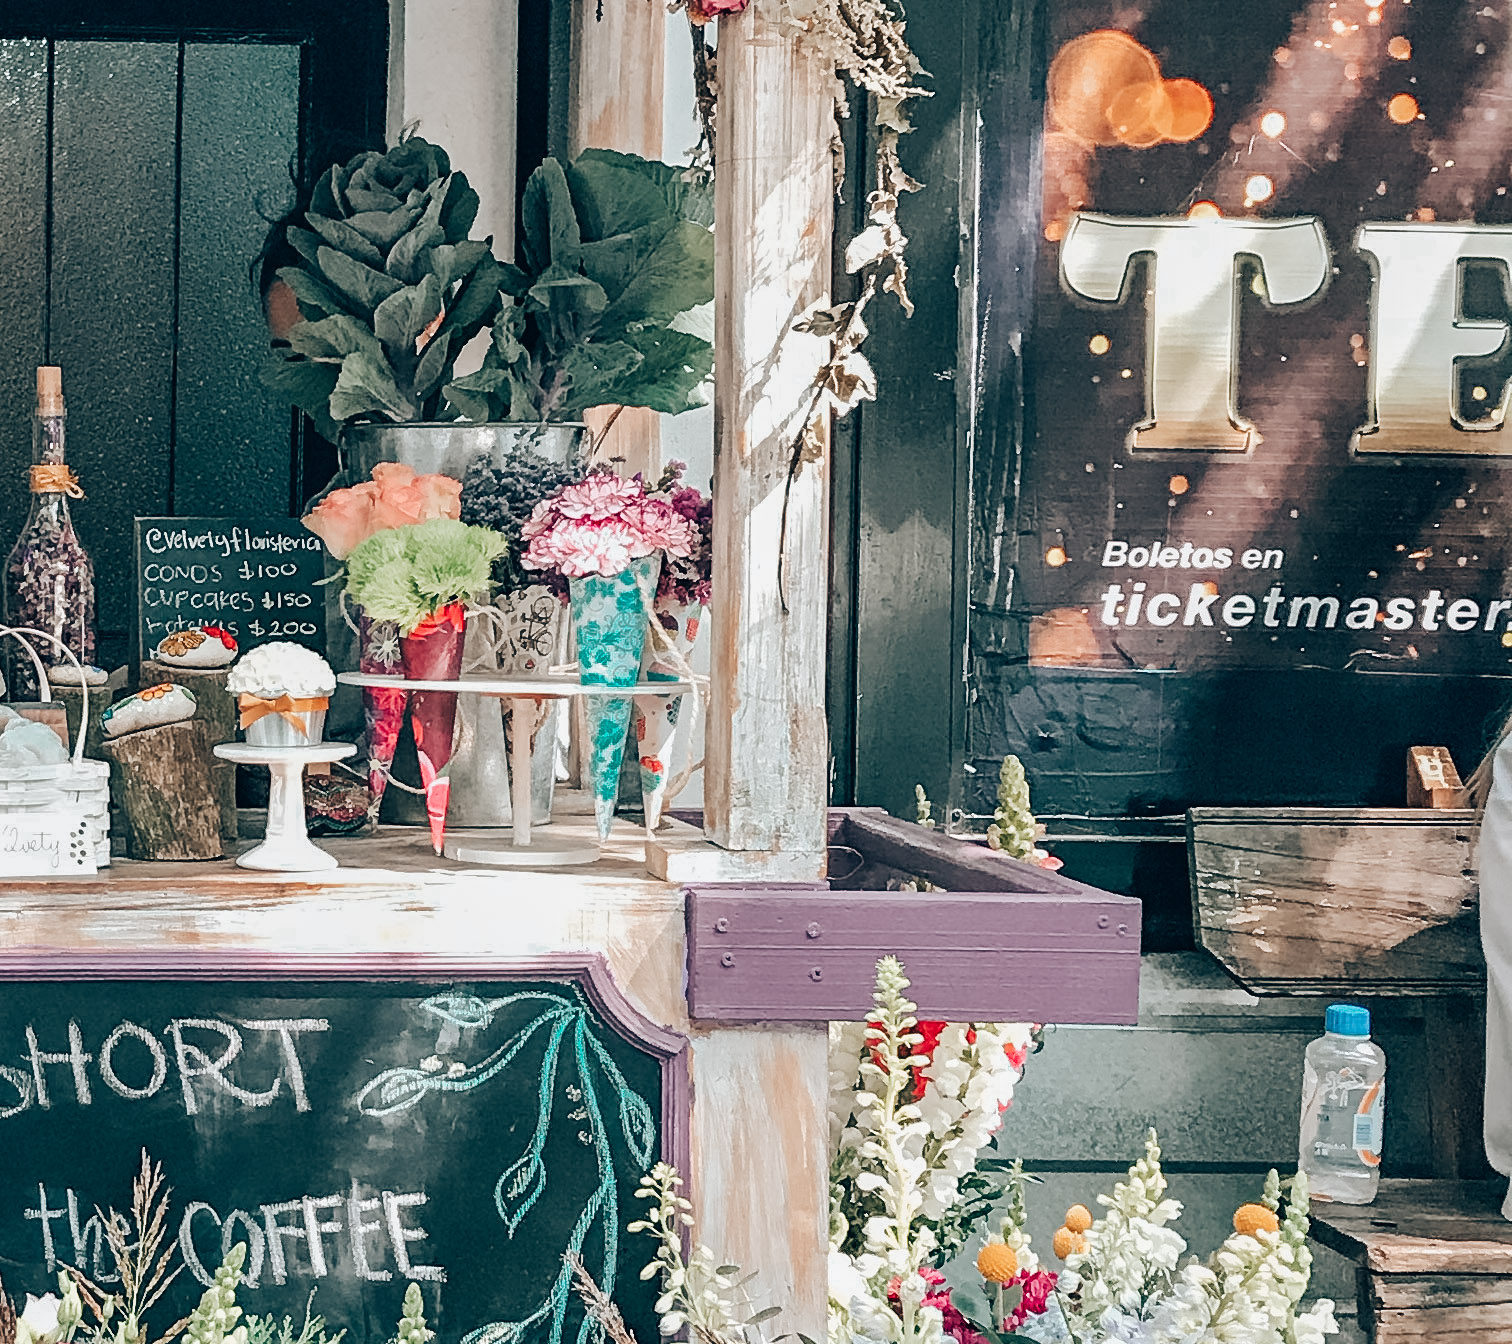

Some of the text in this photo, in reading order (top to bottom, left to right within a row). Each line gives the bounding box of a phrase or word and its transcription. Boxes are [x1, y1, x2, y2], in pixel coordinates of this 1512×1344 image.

[1060, 212, 1512, 456] TE
[1101, 541, 1284, 570] Boletos en
[239, 561, 297, 581] $100
[262, 591, 312, 611] $150
[248, 619, 317, 637] $200
[179, 1189, 447, 1289] COFFEE
